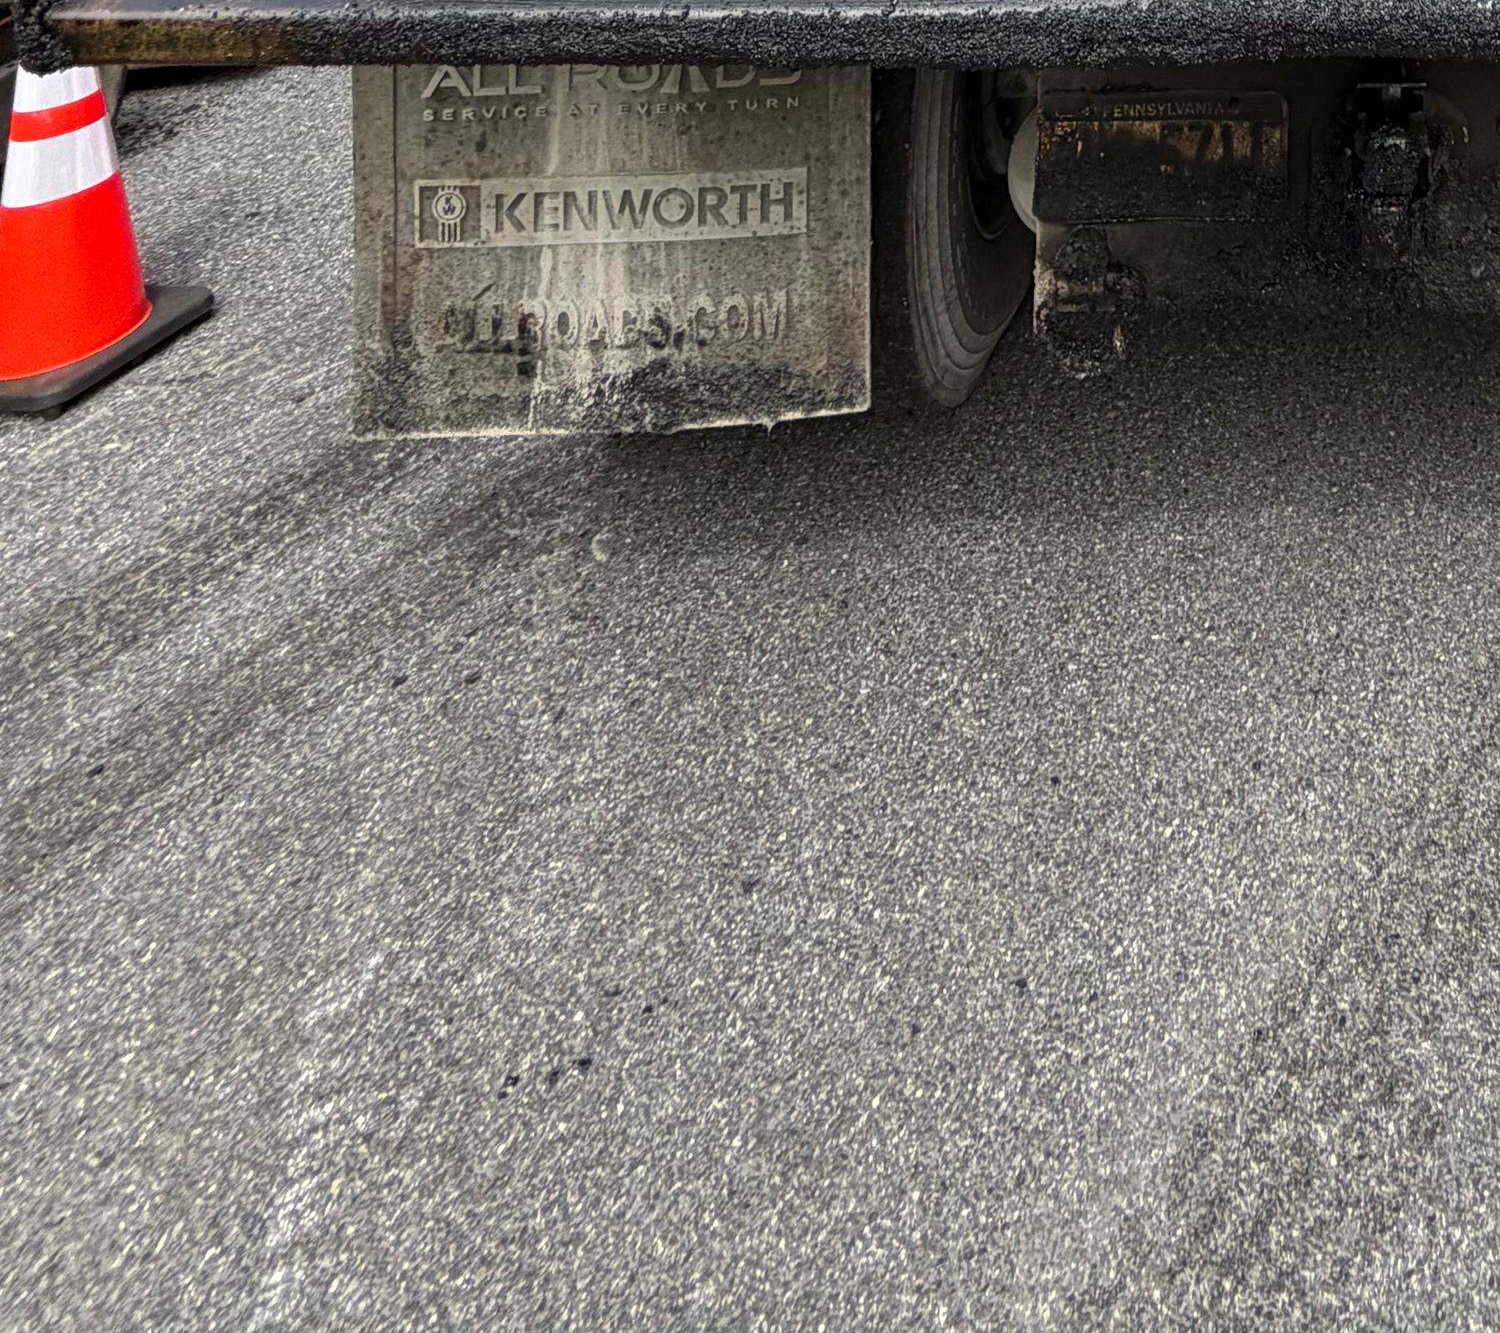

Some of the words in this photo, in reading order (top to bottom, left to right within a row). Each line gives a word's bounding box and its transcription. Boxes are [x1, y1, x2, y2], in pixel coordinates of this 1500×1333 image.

[420, 64, 543, 99] ALL
[422, 105, 548, 122] SERVICE
[568, 102, 599, 116] AT
[618, 101, 707, 116] EVERY
[727, 96, 800, 111] TURN
[1102, 100, 1225, 118] PENNSYLVANIA
[495, 181, 795, 233] KENWORTH
